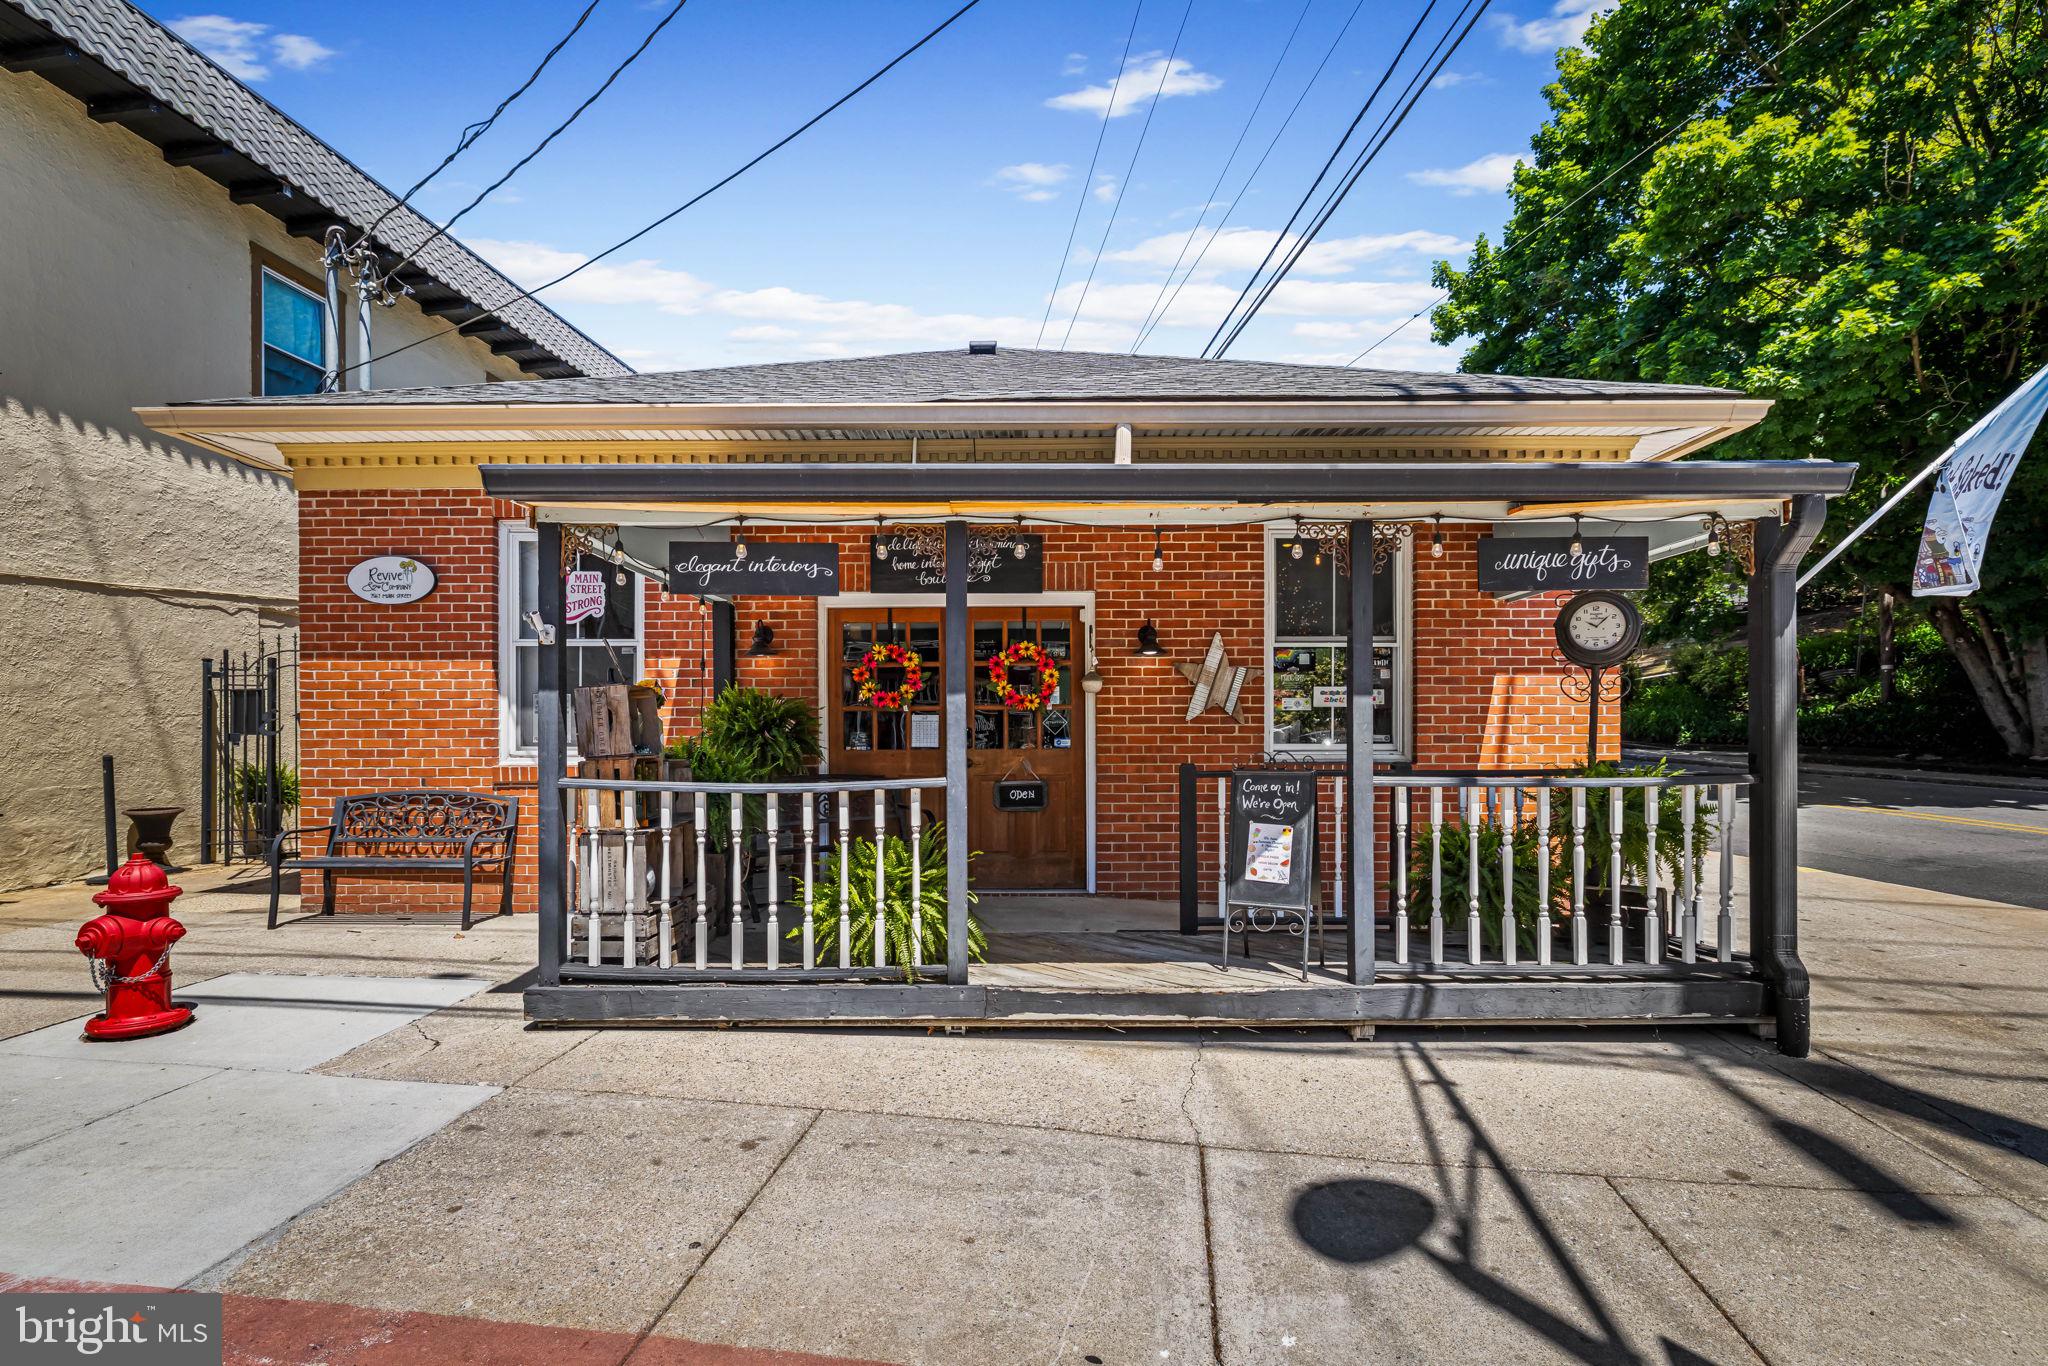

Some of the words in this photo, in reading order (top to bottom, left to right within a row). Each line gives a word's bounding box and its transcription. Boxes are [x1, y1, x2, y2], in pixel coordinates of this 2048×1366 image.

[675, 555, 745, 586] elegant
[749, 556, 833, 578] interiors
[892, 556, 919, 571] home
[1495, 550, 1568, 581] unique
[1570, 544, 1631, 580] gifts
[369, 567, 403, 584] Revive
[574, 574, 599, 583] MAIN
[570, 584, 603, 594] STREET
[566, 596, 603, 613] STRONG
[1242, 778, 1269, 793] Come
[1270, 784, 1282, 796] on
[1285, 780, 1300, 795] in!
[1242, 794, 1270, 809] We're
[1273, 798, 1300, 815] Open
